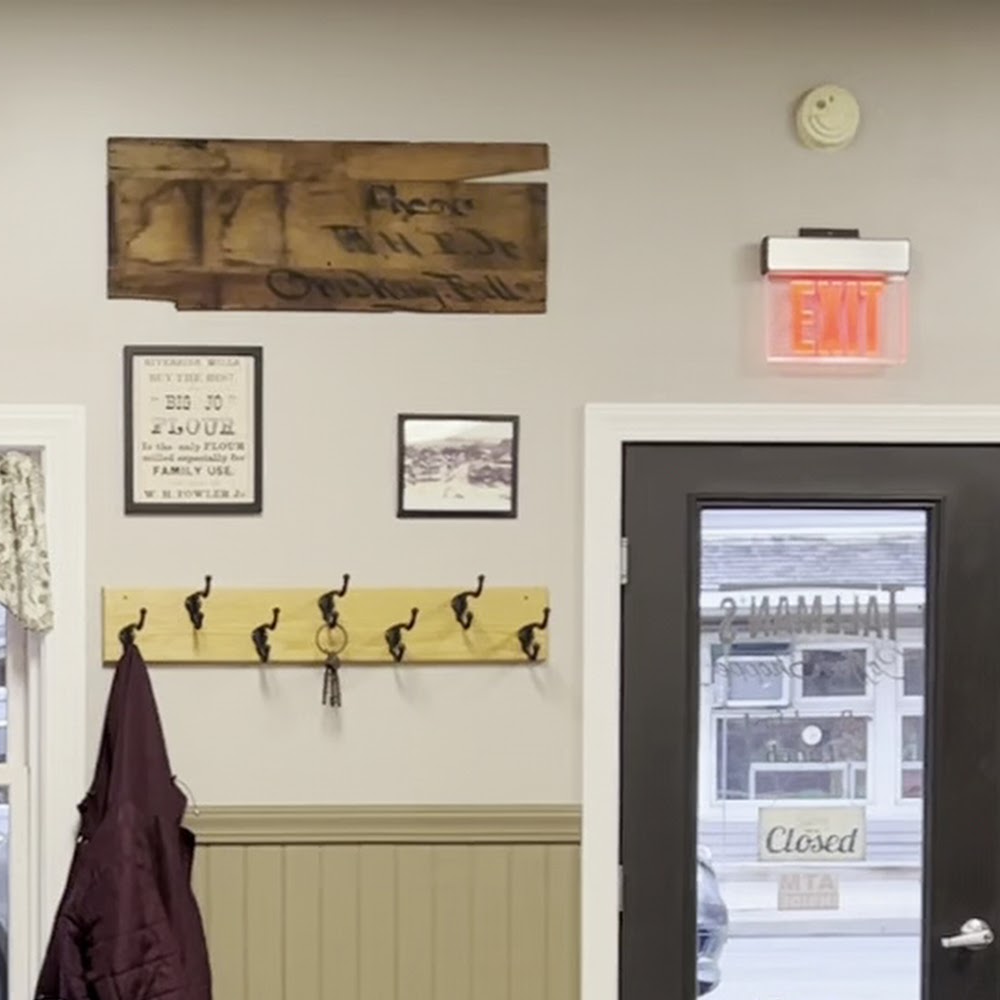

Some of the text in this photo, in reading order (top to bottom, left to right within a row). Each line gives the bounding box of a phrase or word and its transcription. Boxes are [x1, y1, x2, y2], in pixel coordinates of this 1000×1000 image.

[790, 280, 884, 356] EXIT
[165, 394, 192, 411] BIG
[150, 417, 236, 436] FLOUR
[156, 442, 172, 451] the
[204, 441, 245, 451] FLOUR
[152, 466, 202, 476] FAMILY
[766, 825, 859, 854] Closed
